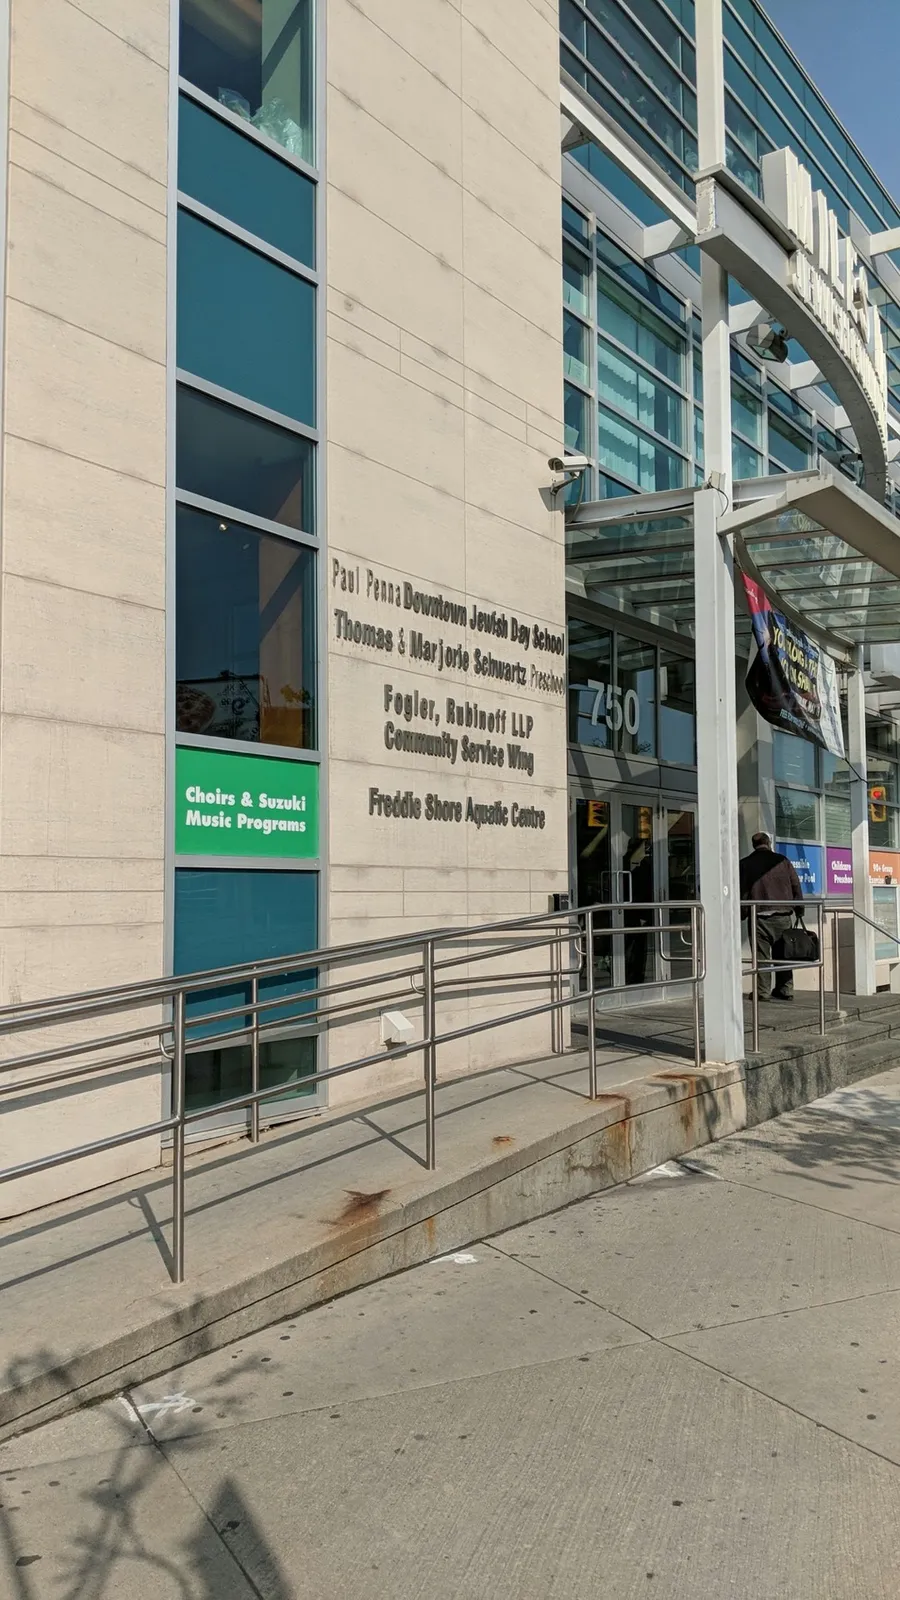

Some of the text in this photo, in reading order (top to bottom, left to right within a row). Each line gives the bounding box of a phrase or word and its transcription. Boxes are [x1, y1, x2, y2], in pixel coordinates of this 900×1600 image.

[332, 557, 564, 657] Paul Penna Downtown Jewish Day School
[333, 608, 565, 695] Thomas & Marjorie Schwartz Preschool
[383, 684, 534, 739] Fogler, Rubinoff LLP
[587, 678, 640, 735] 750
[384, 720, 535, 777] Community Service Wing
[185, 786, 306, 811] Choirs & Suzuki
[185, 810, 306, 835] Music Programs
[368, 787, 546, 830] Freddie Shore Aquatic Centre
[831, 860, 852, 871] Childcare
[833, 873, 853, 884] Preschoo
